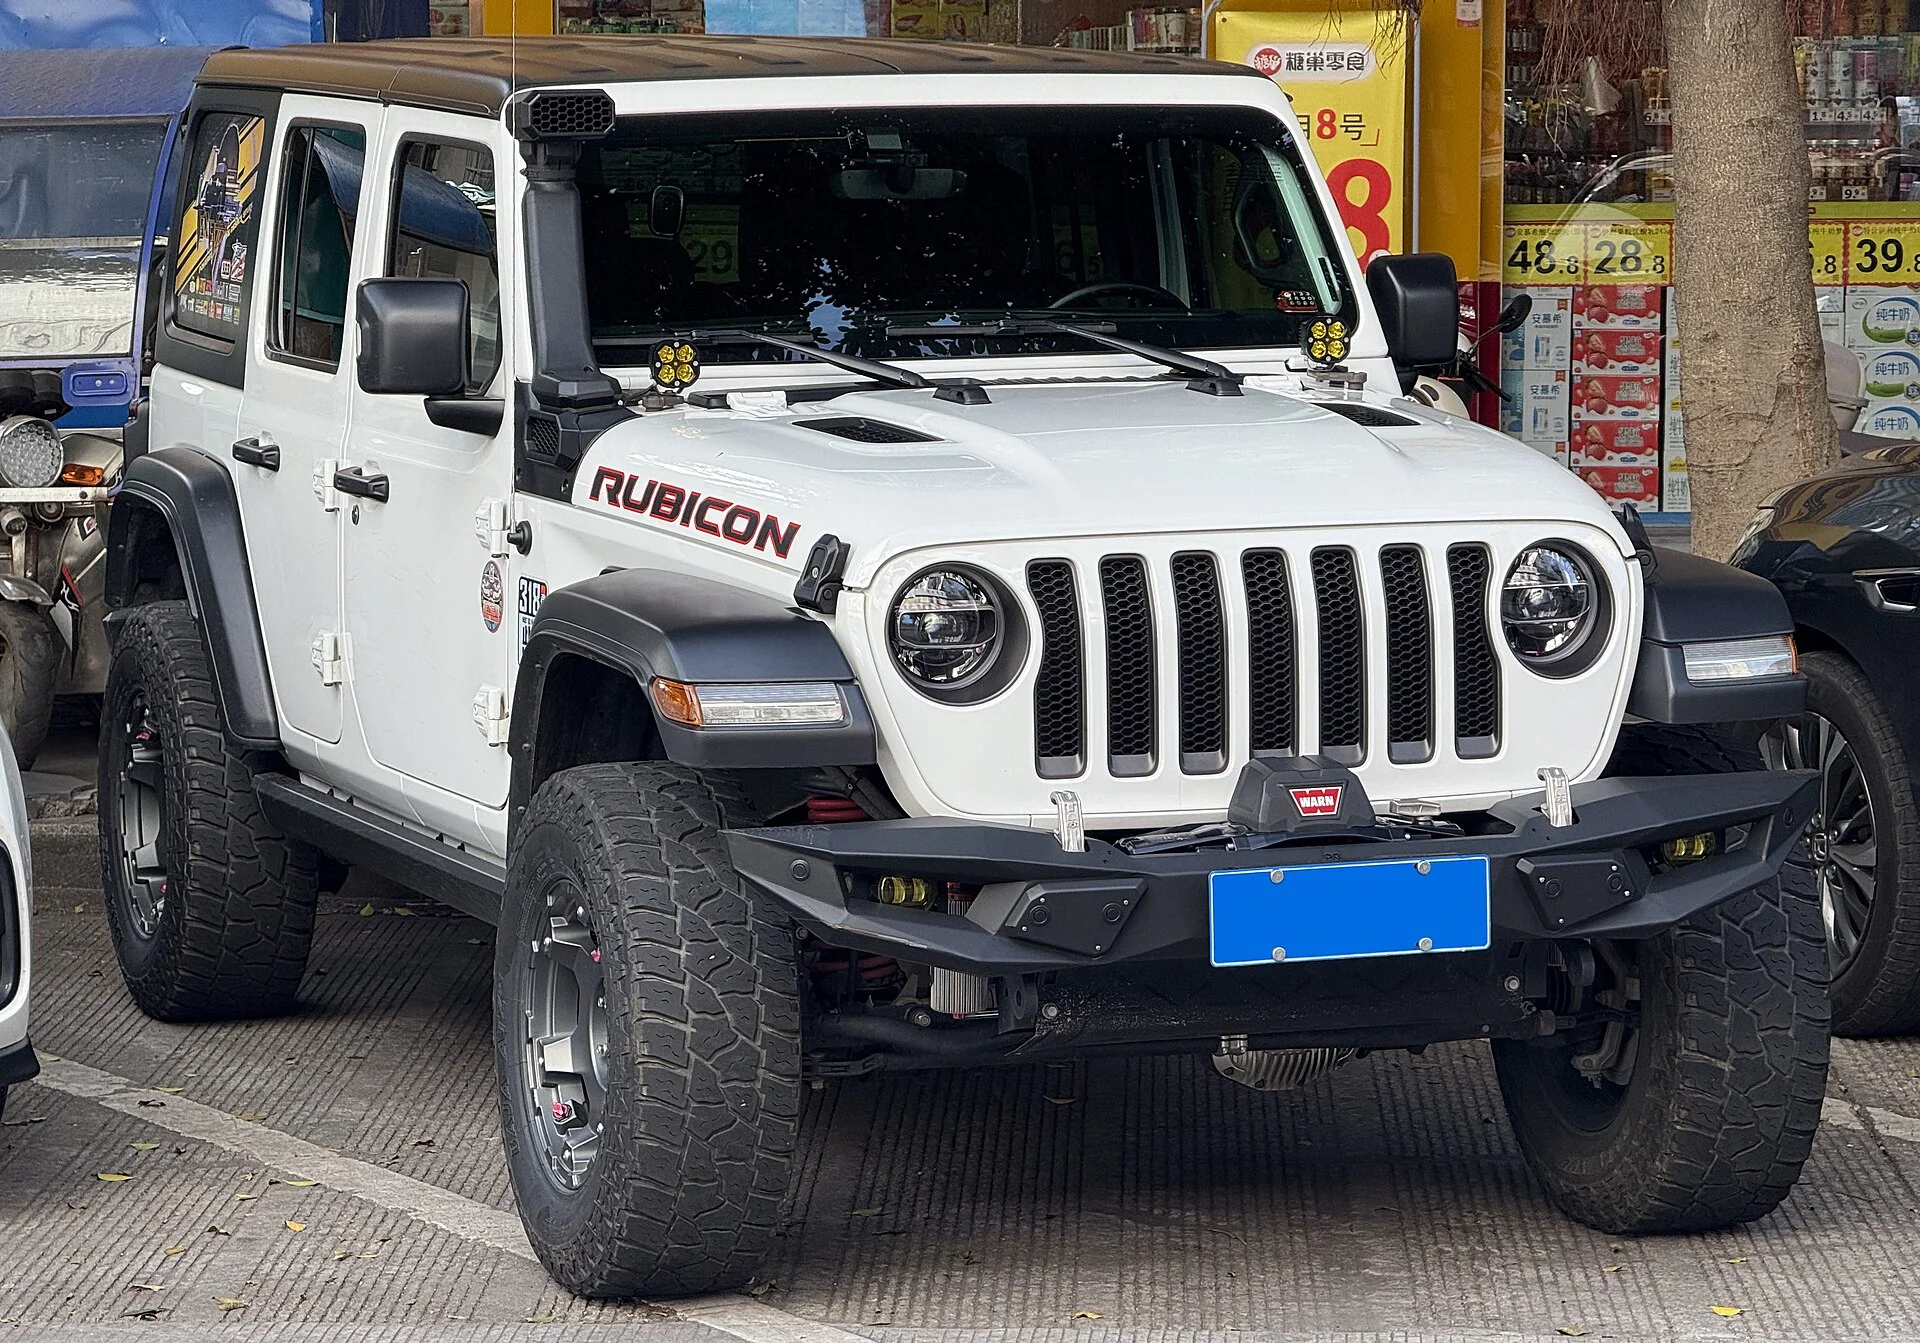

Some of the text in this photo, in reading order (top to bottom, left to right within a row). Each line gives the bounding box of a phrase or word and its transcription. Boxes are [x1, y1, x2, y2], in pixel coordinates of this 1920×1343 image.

[1285, 52, 1365, 72] 糖巢零食
[1844, 188, 1860, 199] 9.9
[1507, 239, 1579, 274] 48.8
[1594, 239, 1665, 274] 28.8
[1532, 313, 1562, 325] 安慕希
[1876, 308, 1910, 321] 纯牛奶
[1875, 362, 1909, 376] 纯牛奶
[1530, 384, 1560, 396] 安慕希
[1874, 417, 1909, 431] 纯牛奶
[589, 466, 801, 559] RUBICON
[519, 578, 541, 616] 318
[1299, 795, 1335, 808] WARN
